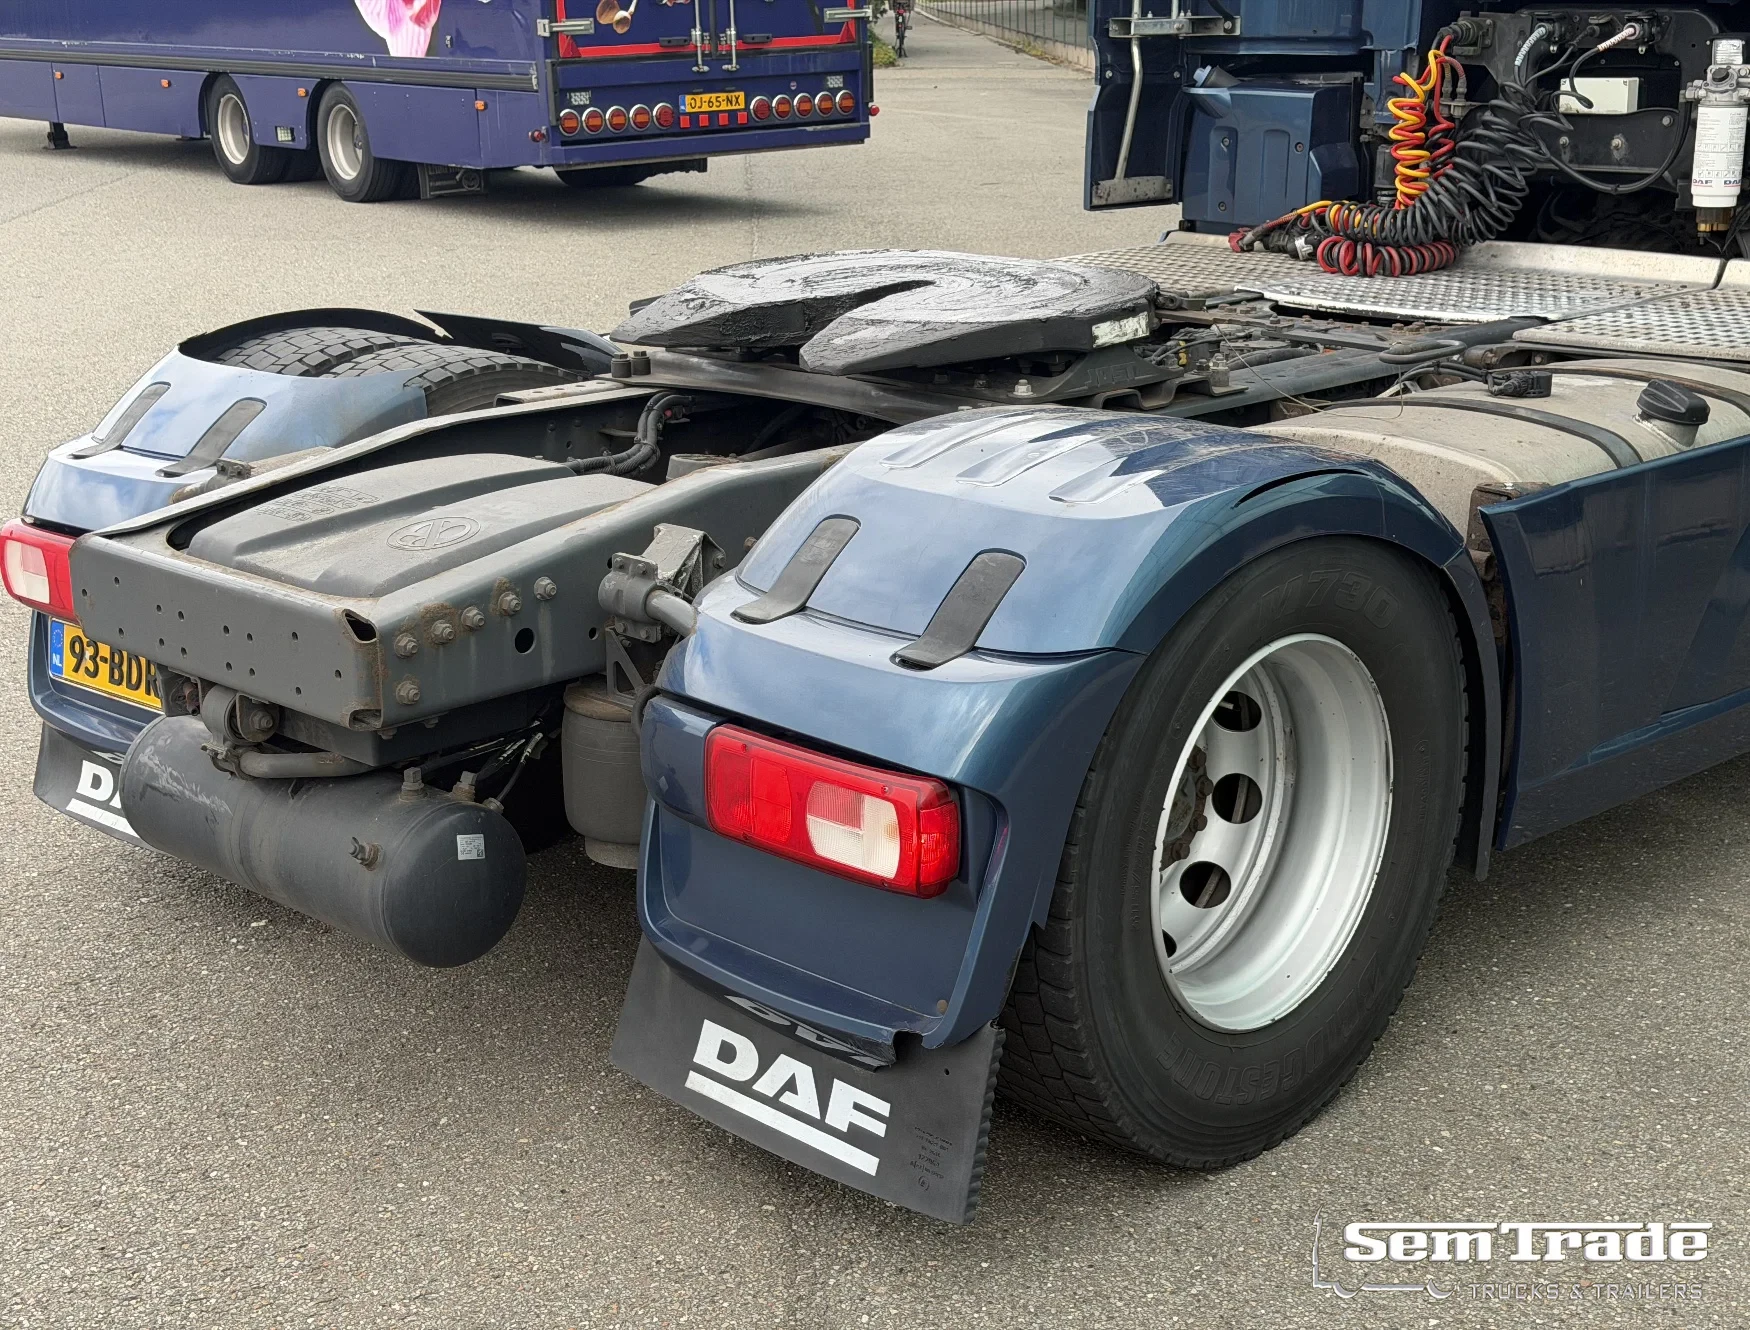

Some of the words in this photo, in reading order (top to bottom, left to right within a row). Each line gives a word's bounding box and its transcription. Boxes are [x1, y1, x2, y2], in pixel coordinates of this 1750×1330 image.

[689, 94, 741, 110] OJ-65-NX
[52, 652, 62, 667] NL
[69, 634, 161, 699] 93-BDR
[692, 1018, 891, 1139] DAF
